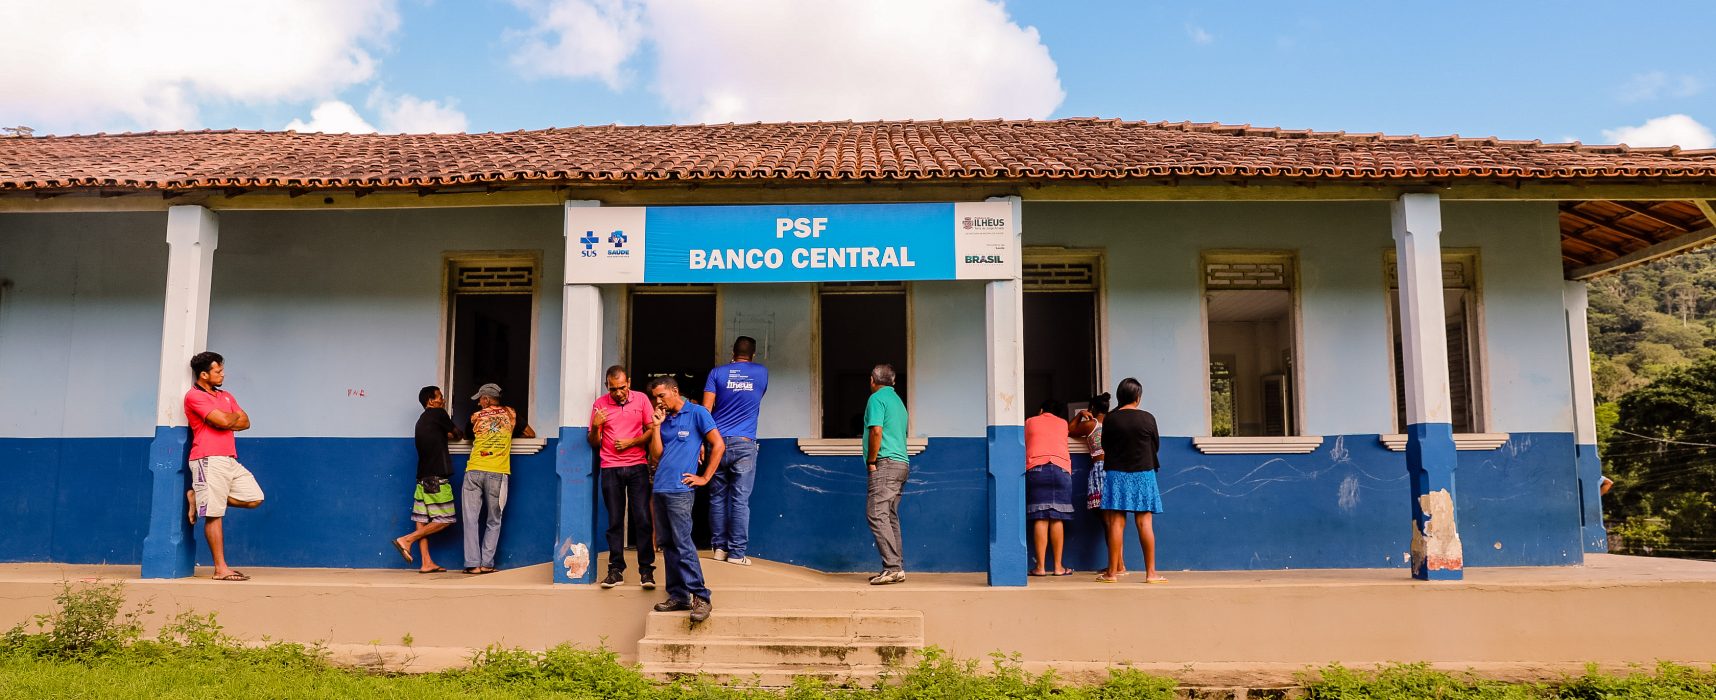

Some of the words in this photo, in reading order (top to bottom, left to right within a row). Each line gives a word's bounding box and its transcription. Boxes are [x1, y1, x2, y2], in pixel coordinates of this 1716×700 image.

[776, 217, 828, 238] PSF
[689, 248, 783, 269] BANCO
[791, 246, 916, 268] CENTRAL
[964, 255, 1004, 264] BRASIL
